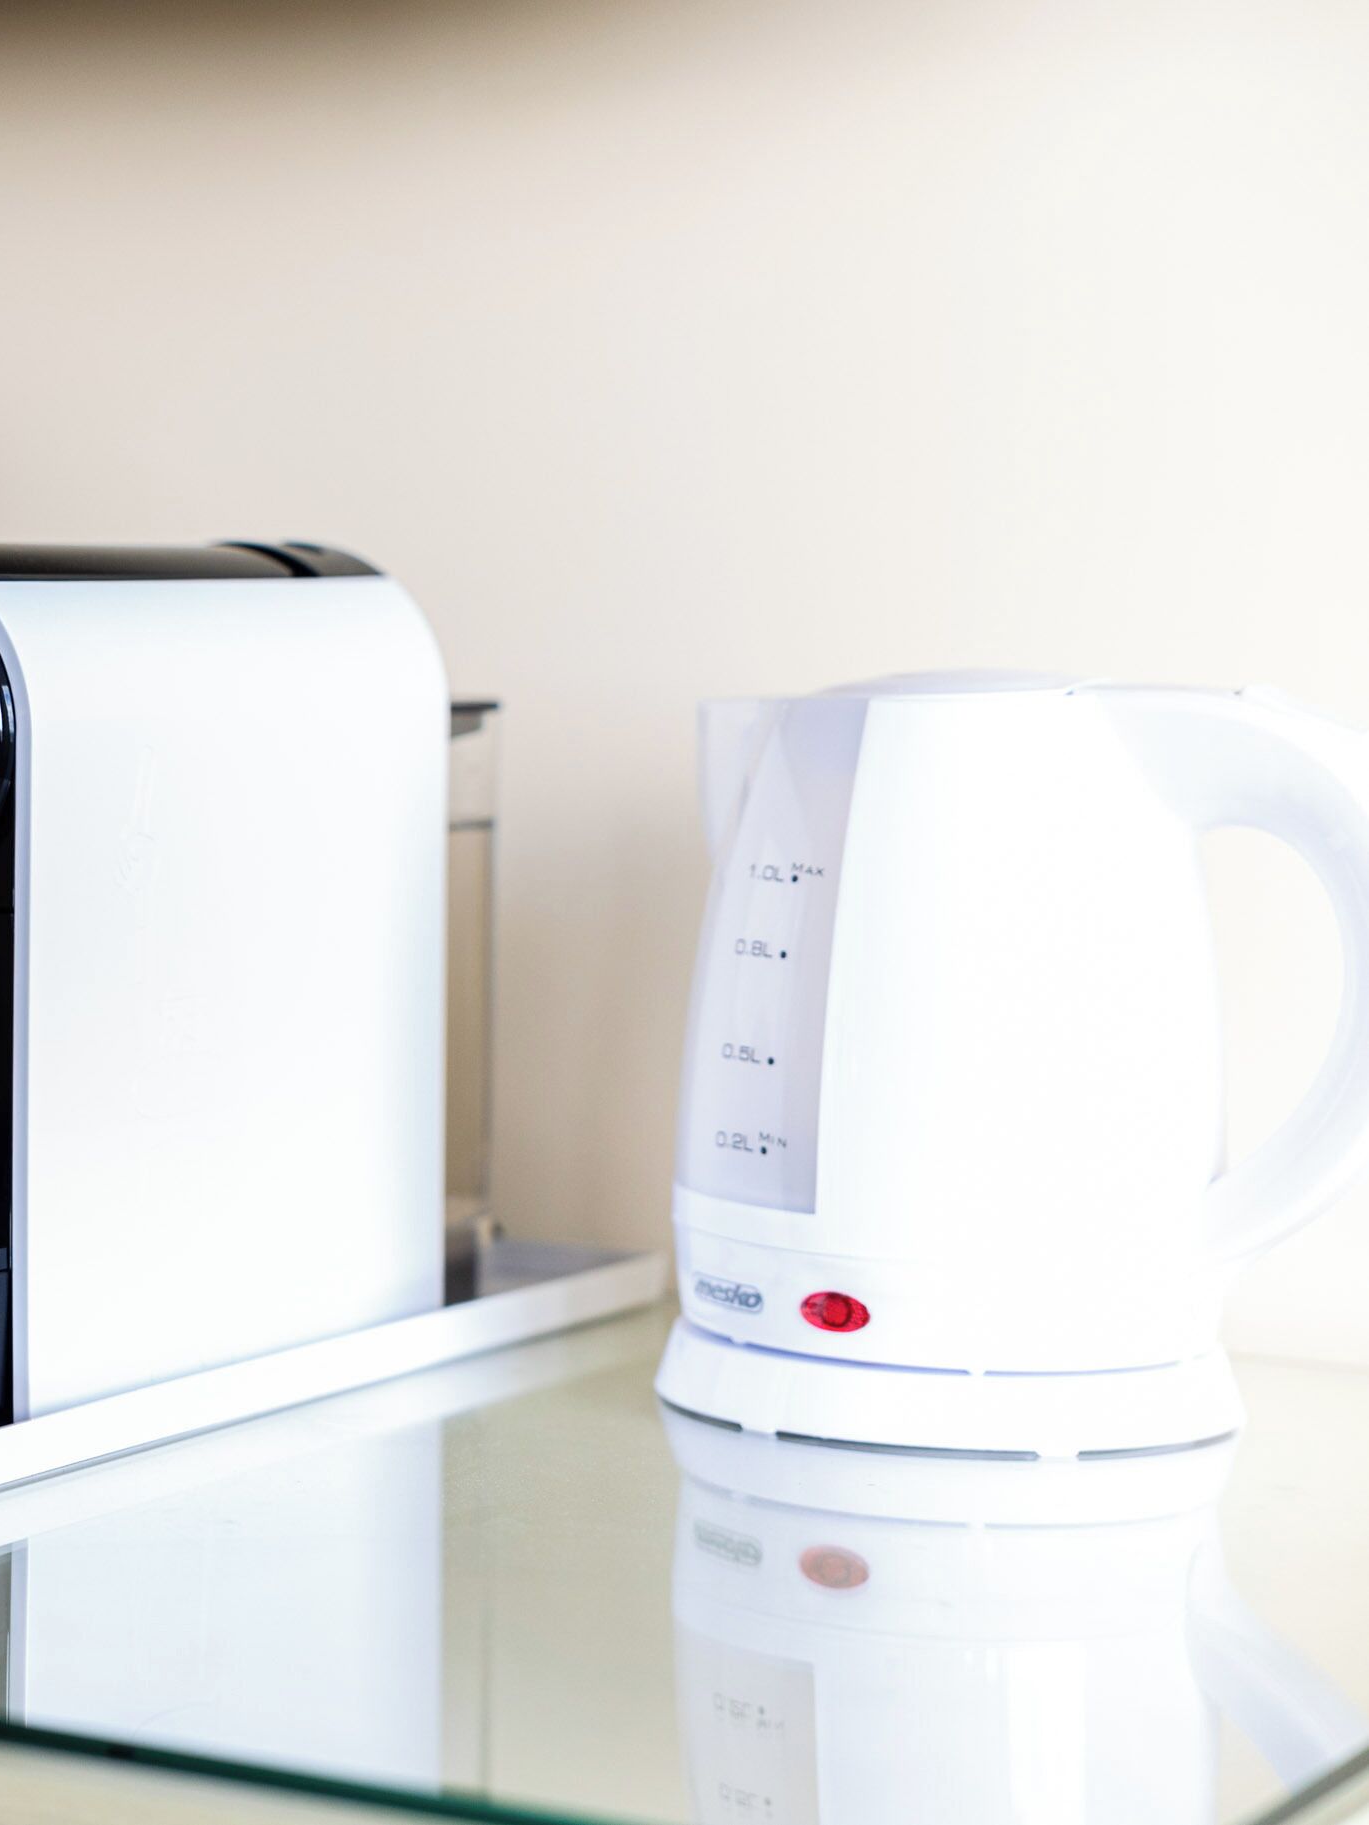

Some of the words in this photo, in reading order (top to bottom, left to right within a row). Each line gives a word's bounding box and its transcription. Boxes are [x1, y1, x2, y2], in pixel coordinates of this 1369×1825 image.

[750, 863, 784, 882] 1.0L
[734, 938, 773, 958] 0.8L
[721, 1043, 761, 1064] 0.5L
[715, 1130, 753, 1153] 0.2L
